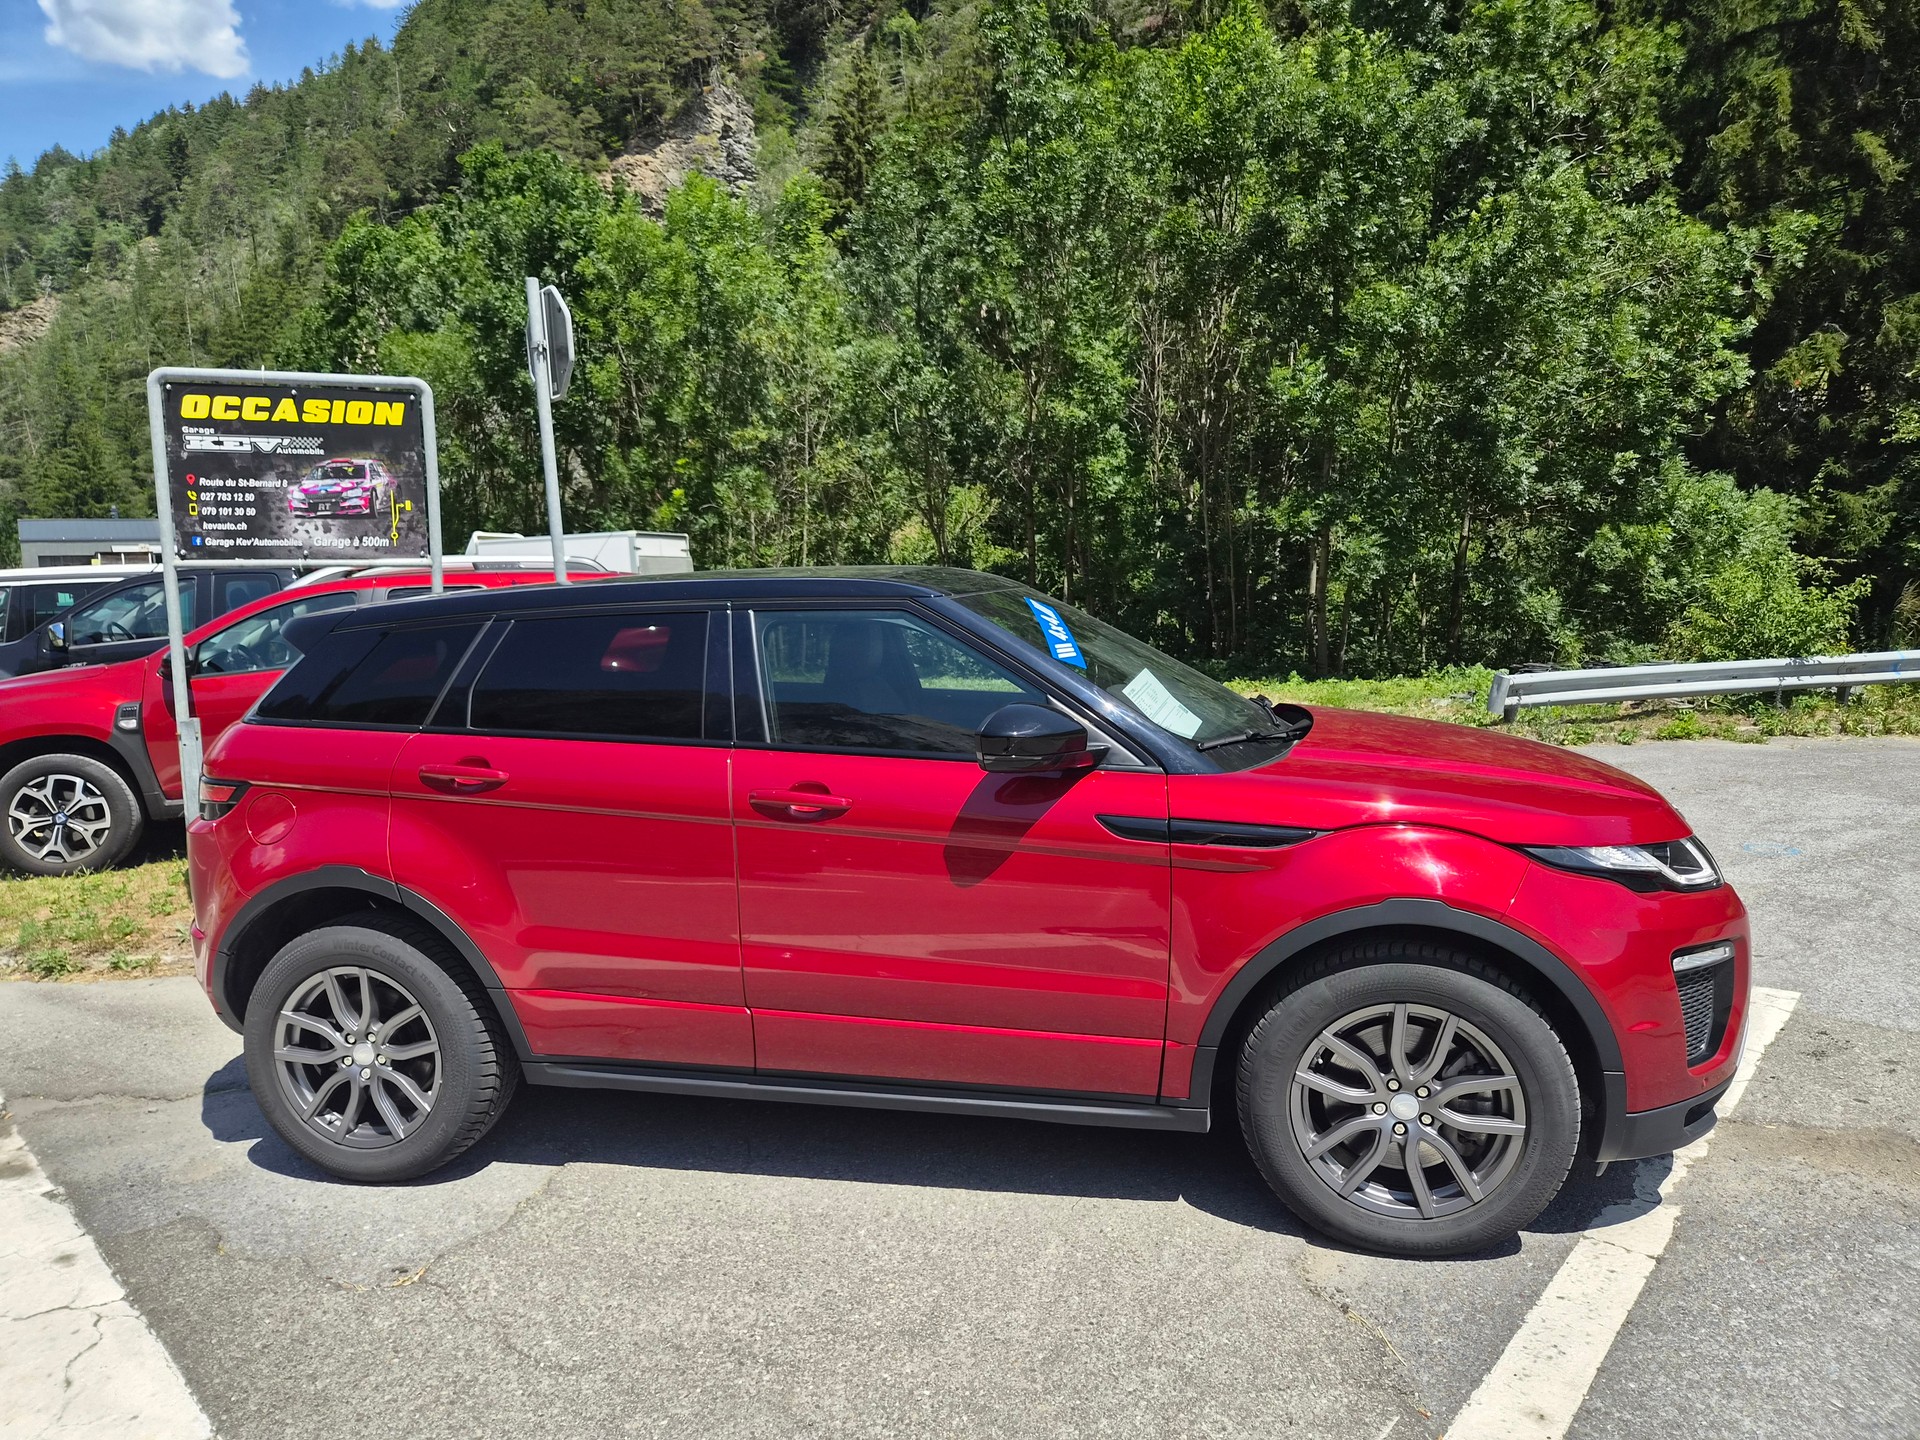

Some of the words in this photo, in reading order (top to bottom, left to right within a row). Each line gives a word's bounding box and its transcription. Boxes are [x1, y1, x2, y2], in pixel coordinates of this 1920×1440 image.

[180, 394, 406, 425] OCCASION
[181, 426, 215, 435] Garage
[276, 446, 325, 455] Automobile
[199, 477, 224, 487] Route
[225, 477, 236, 487] du
[238, 478, 281, 488] St-Bernard
[200, 492, 214, 501] 027
[217, 492, 232, 502] 783
[233, 493, 243, 502] 12
[245, 493, 255, 502] 50
[201, 507, 217, 516] 079
[218, 507, 233, 516] 101
[234, 507, 245, 516] 30
[246, 507, 256, 517] 50
[203, 521, 247, 531] kevauto.ch
[205, 537, 234, 548] Garage
[313, 537, 350, 548] Garage
[353, 536, 360, 547] à
[361, 536, 390, 547] 500m
